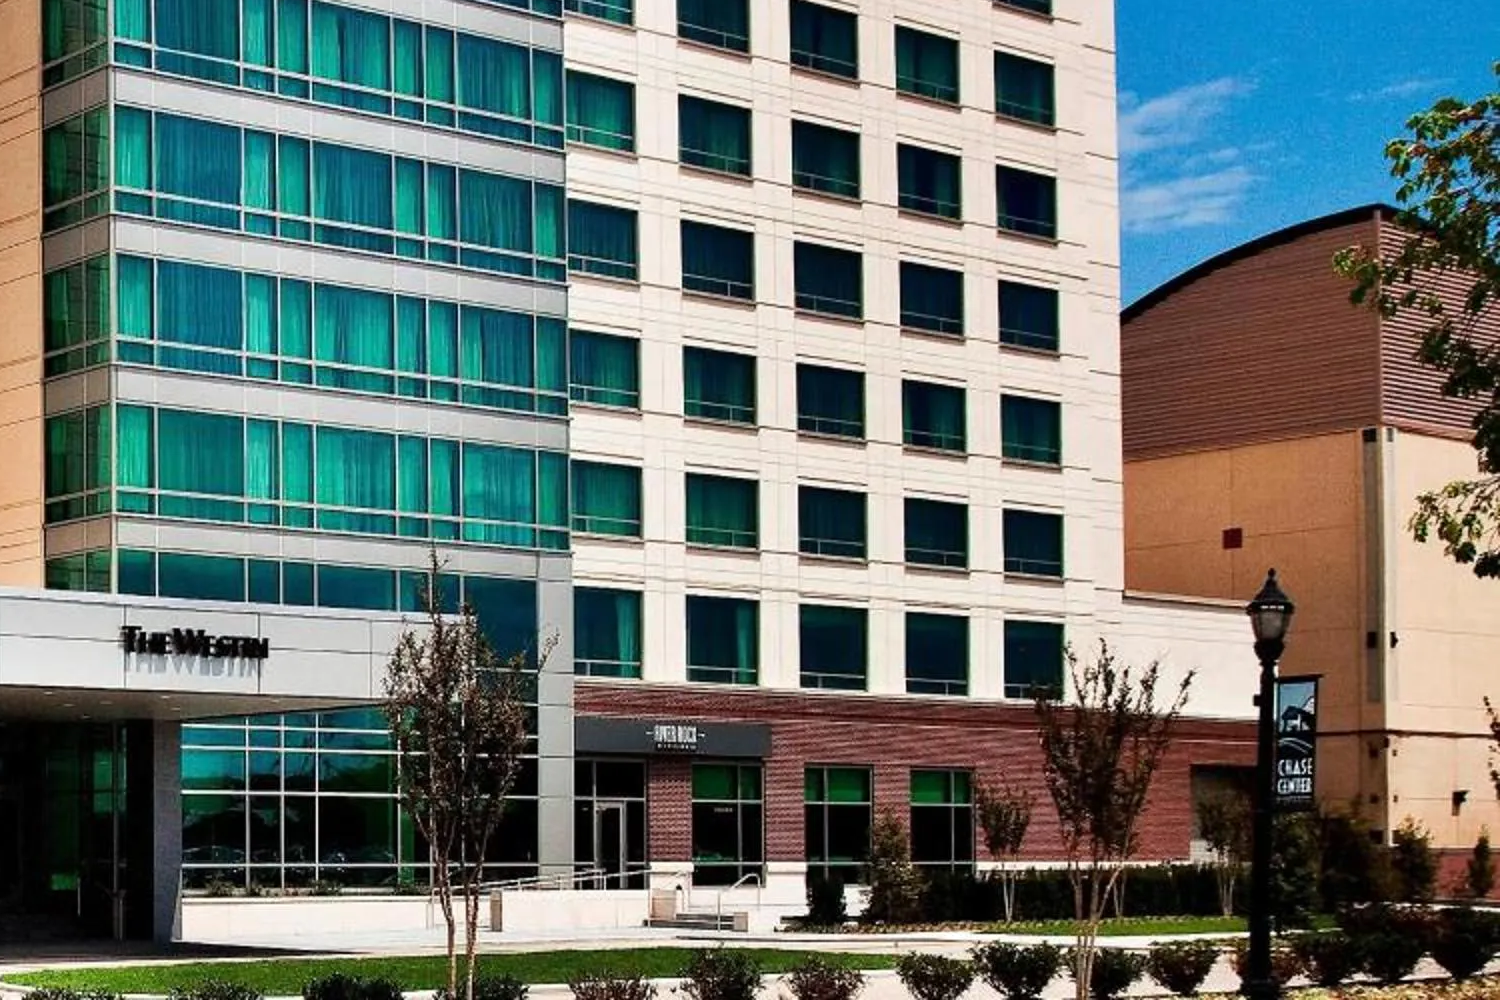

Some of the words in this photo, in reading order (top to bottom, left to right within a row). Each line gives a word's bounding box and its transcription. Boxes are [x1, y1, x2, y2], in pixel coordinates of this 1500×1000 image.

[120, 625, 172, 654] THE
[172, 628, 269, 659] WESTIN
[1277, 758, 1313, 776] CHASE
[1277, 777, 1313, 795] CENTER
